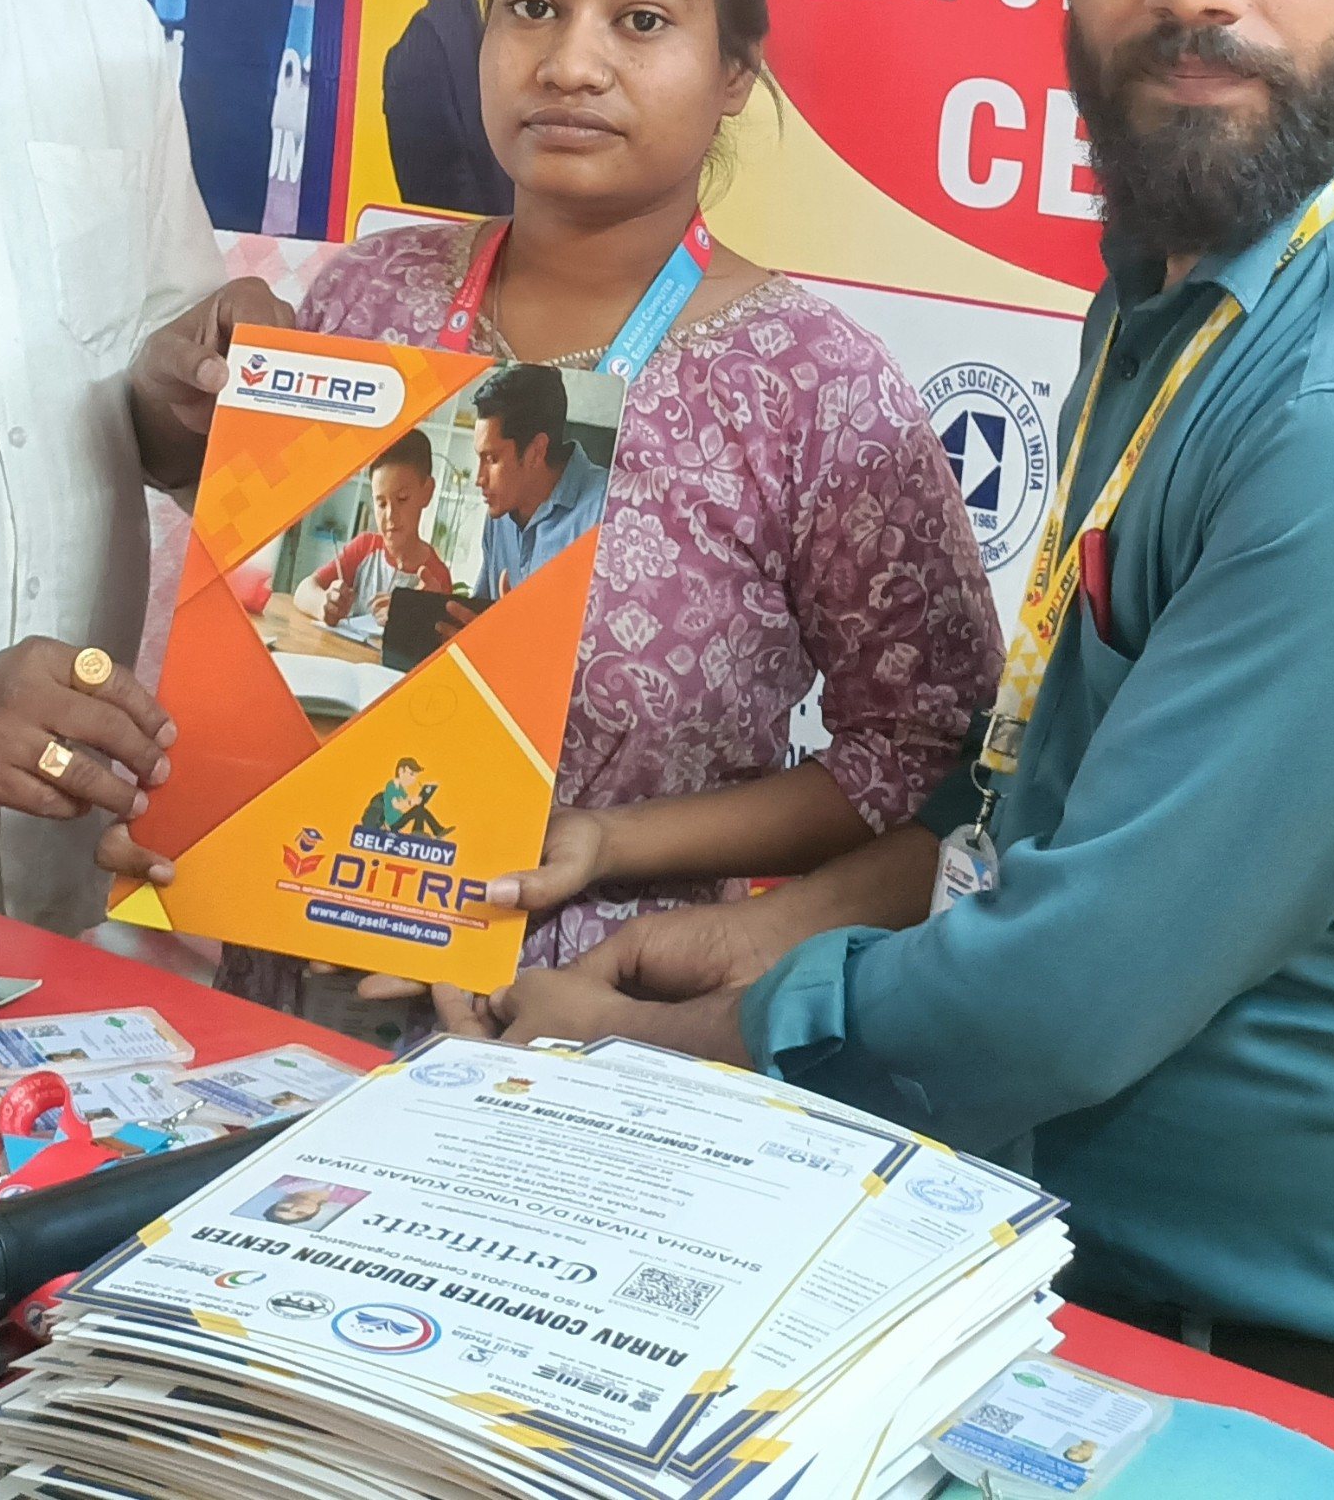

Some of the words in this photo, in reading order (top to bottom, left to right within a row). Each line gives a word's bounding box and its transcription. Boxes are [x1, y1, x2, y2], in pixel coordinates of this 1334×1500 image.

[1031, 381, 1051, 398] TM
[958, 368, 1019, 404] SOCIETY
[1016, 403, 1036, 428] OF
[1027, 435, 1045, 491] INDIA
[353, 831, 454, 864] SELF-STUDY
[309, 904, 449, 942] www.ditrpself-study.com
[474, 1095, 530, 1112] CENTER
[532, 1107, 613, 1131] EDUCATION
[615, 1125, 698, 1153] COMPUTER
[296, 1153, 367, 1174] TIWARI
[373, 1167, 450, 1191] KUMAR
[452, 1186, 520, 1207] VINOD
[524, 1202, 569, 1219] D/O
[573, 1213, 648, 1241] TIWARI
[191, 1226, 291, 1257] CENTER
[309, 1234, 399, 1260] Organization
[404, 1255, 468, 1277] Certified
[656, 1235, 763, 1273] SHARDHA
[291, 1247, 438, 1292] EDUCATION
[439, 1282, 588, 1336] COMPUTER
[553, 1295, 581, 1311] ISO
[584, 1303, 605, 1315] An
[451, 1329, 492, 1349] India
[493, 1342, 529, 1359] Skill
[590, 1327, 689, 1367] AARAV
